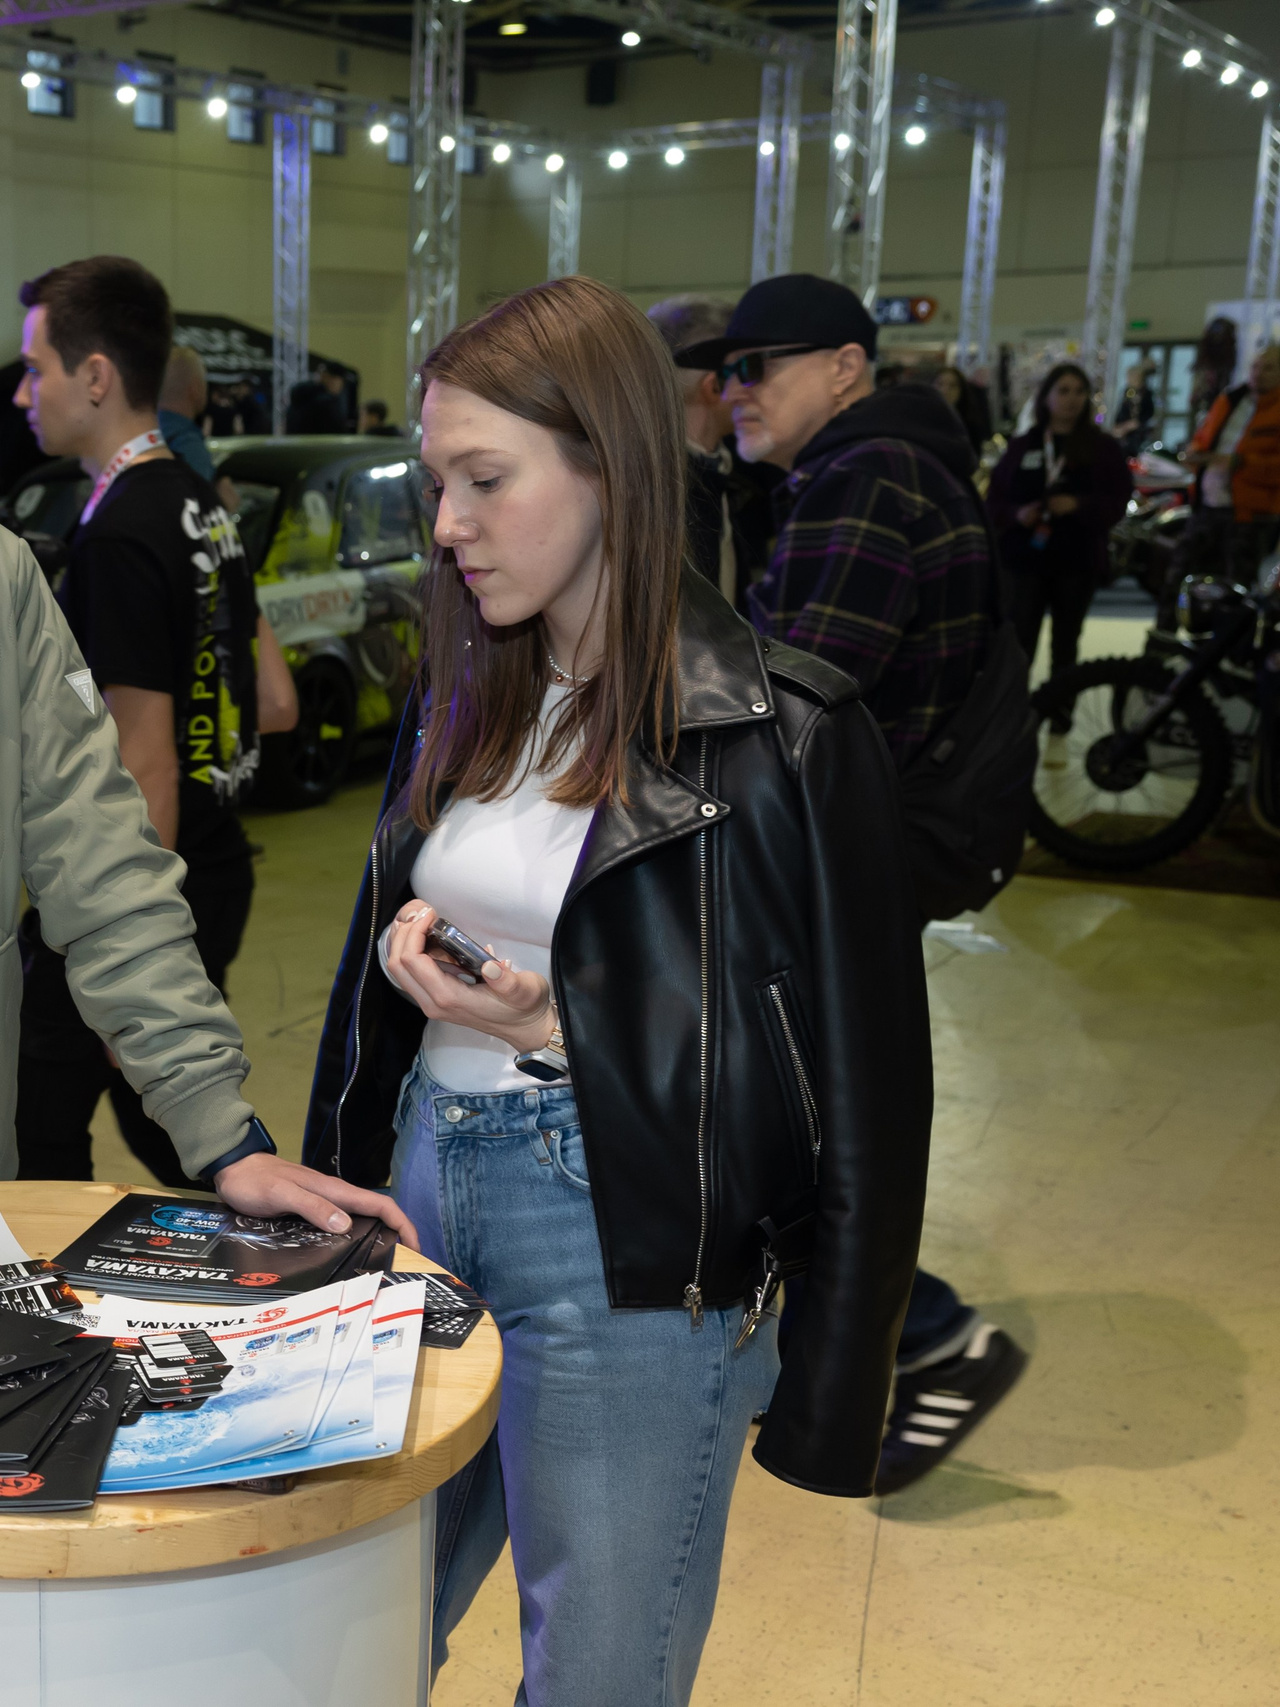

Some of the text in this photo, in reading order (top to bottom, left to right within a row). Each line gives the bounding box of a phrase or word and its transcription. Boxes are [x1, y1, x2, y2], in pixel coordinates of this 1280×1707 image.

[188, 714, 214, 784] AND
[176, 1217, 221, 1227] 10W-40
[127, 1227, 208, 1242] TAKAYAMA
[84, 1267, 185, 1281] МОТОРНЫЕ МАСЛА
[86, 1259, 229, 1281] TAKAYAMA
[126, 1318, 248, 1330] TAKAYAMA
